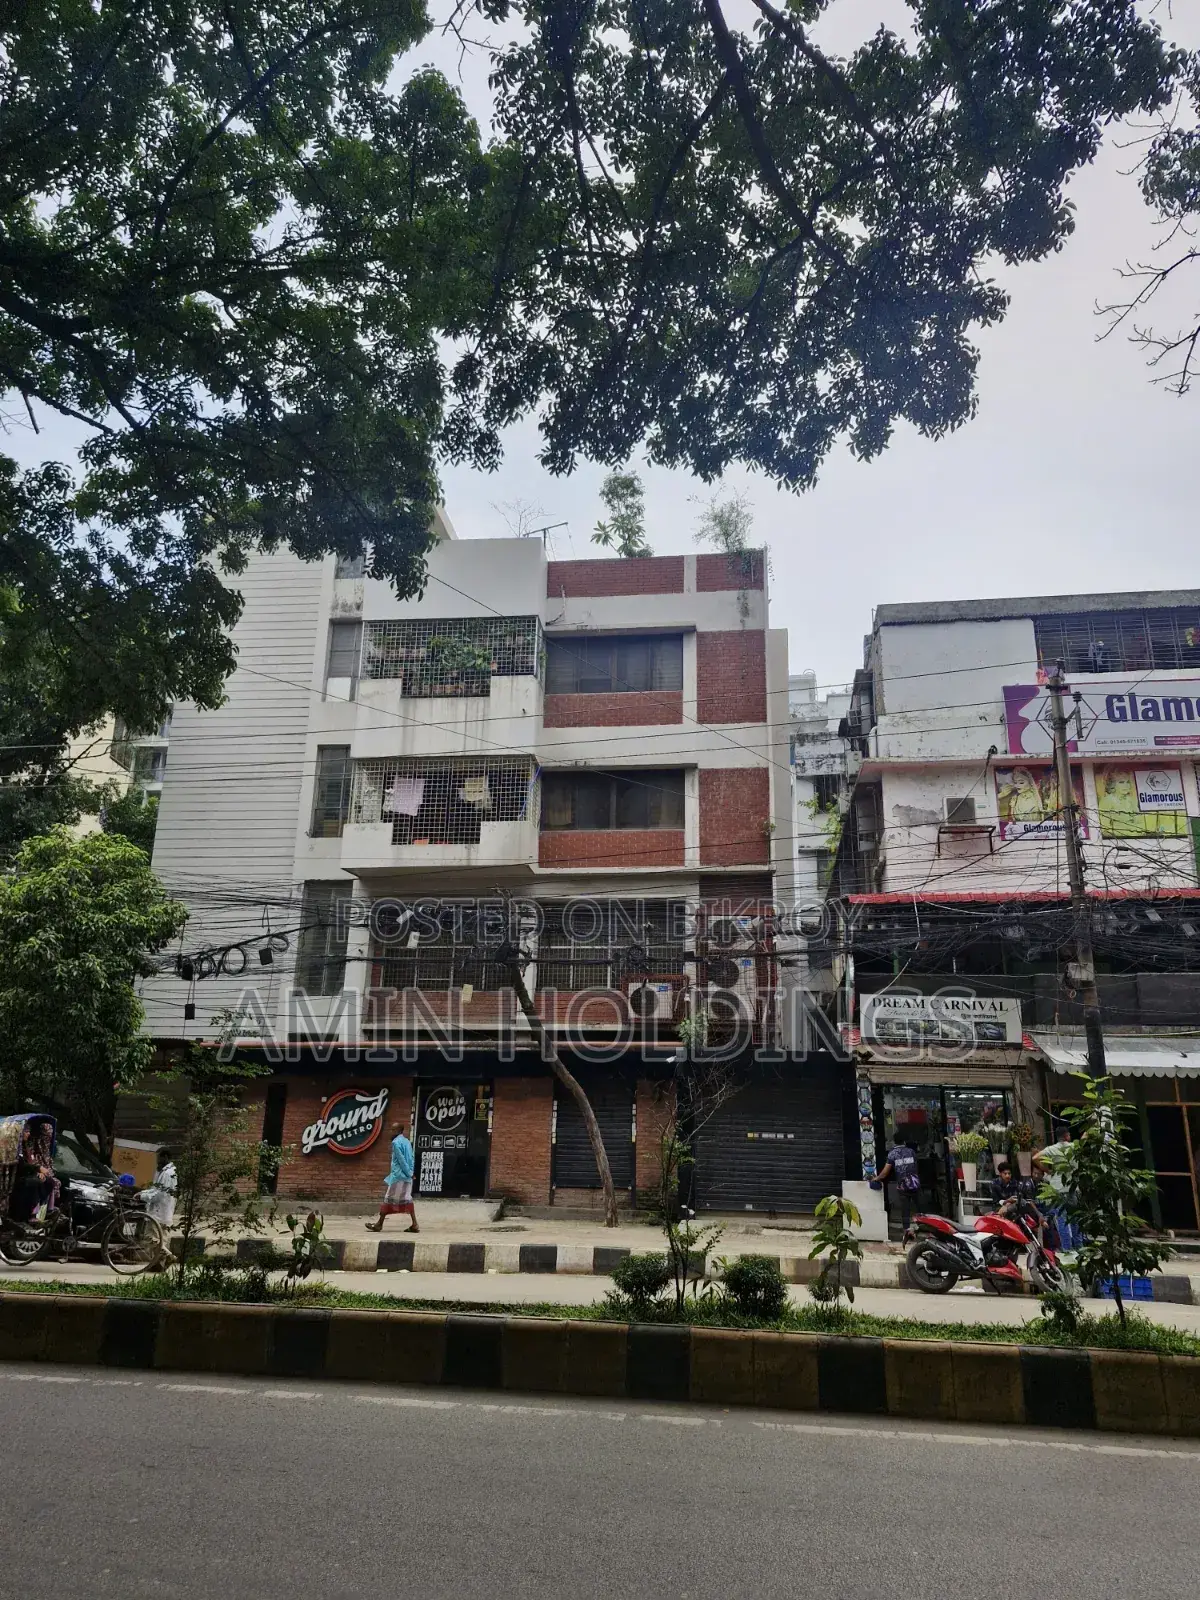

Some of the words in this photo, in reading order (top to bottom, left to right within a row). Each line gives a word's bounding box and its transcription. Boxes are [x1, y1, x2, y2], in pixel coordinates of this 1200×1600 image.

[1139, 792, 1184, 803] Glamorous
[872, 997, 926, 1009] DREAM
[930, 999, 1009, 1012] CARNIVAL
[301, 1087, 389, 1154] ground
[425, 1104, 467, 1123] Open
[336, 1123, 373, 1142] BISTRO
[421, 1151, 445, 1160] COFFEE
[420, 1173, 443, 1181] PASTA
